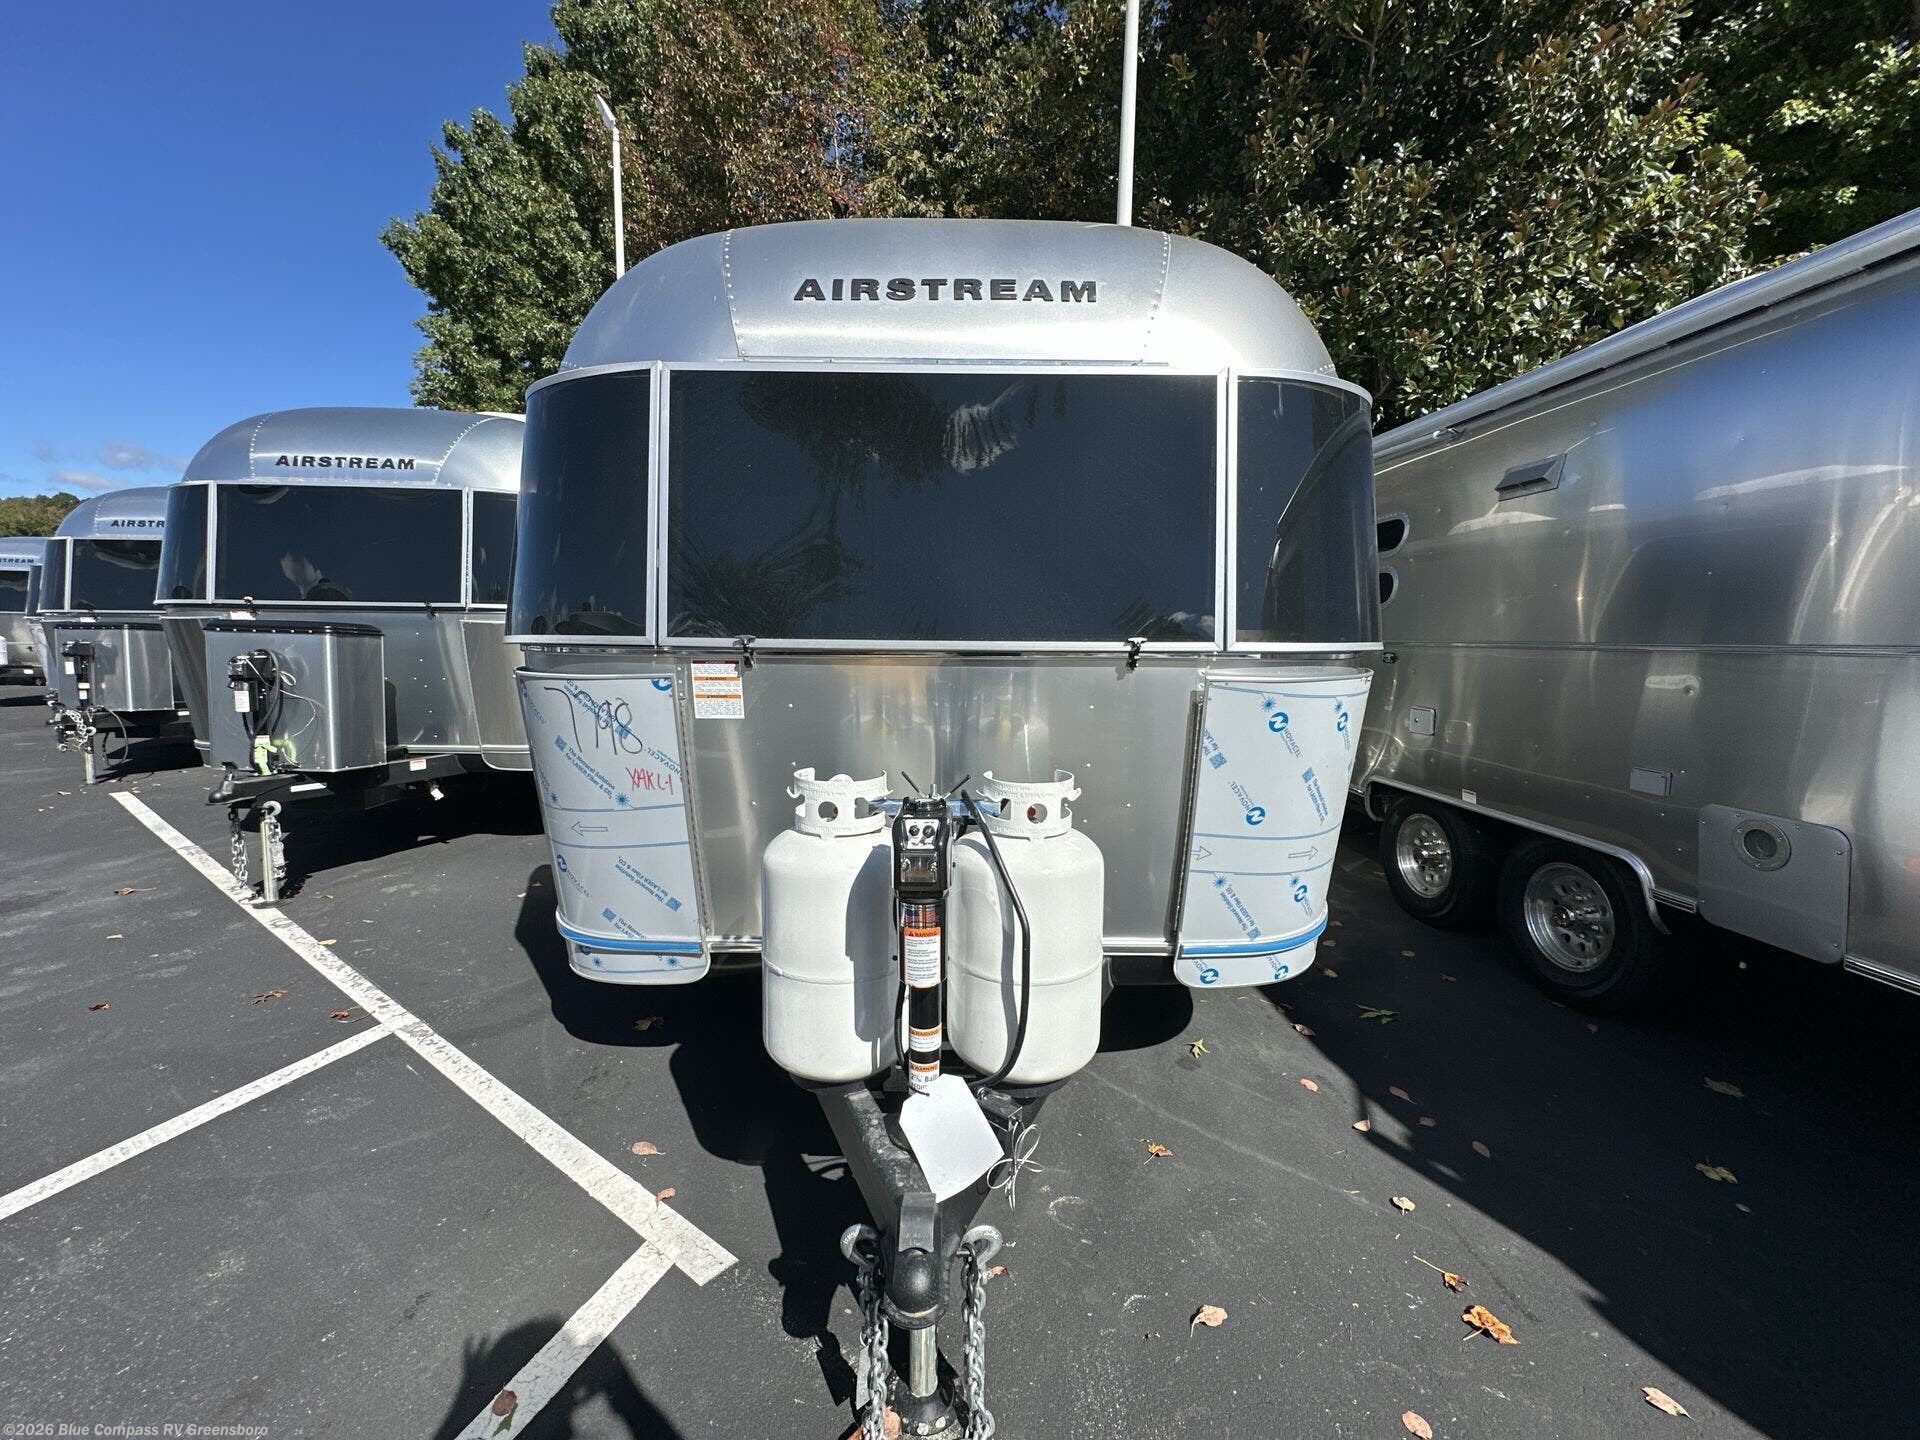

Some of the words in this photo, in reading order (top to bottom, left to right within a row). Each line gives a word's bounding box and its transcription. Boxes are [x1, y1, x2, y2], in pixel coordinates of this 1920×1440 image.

[793, 278, 1097, 303] AIRSTREAM
[275, 455, 416, 470] AIRSTREAM
[111, 519, 165, 528] AIRSTR
[1284, 728, 1302, 758] NOVACEL
[1231, 781, 1252, 811] NOVACEL
